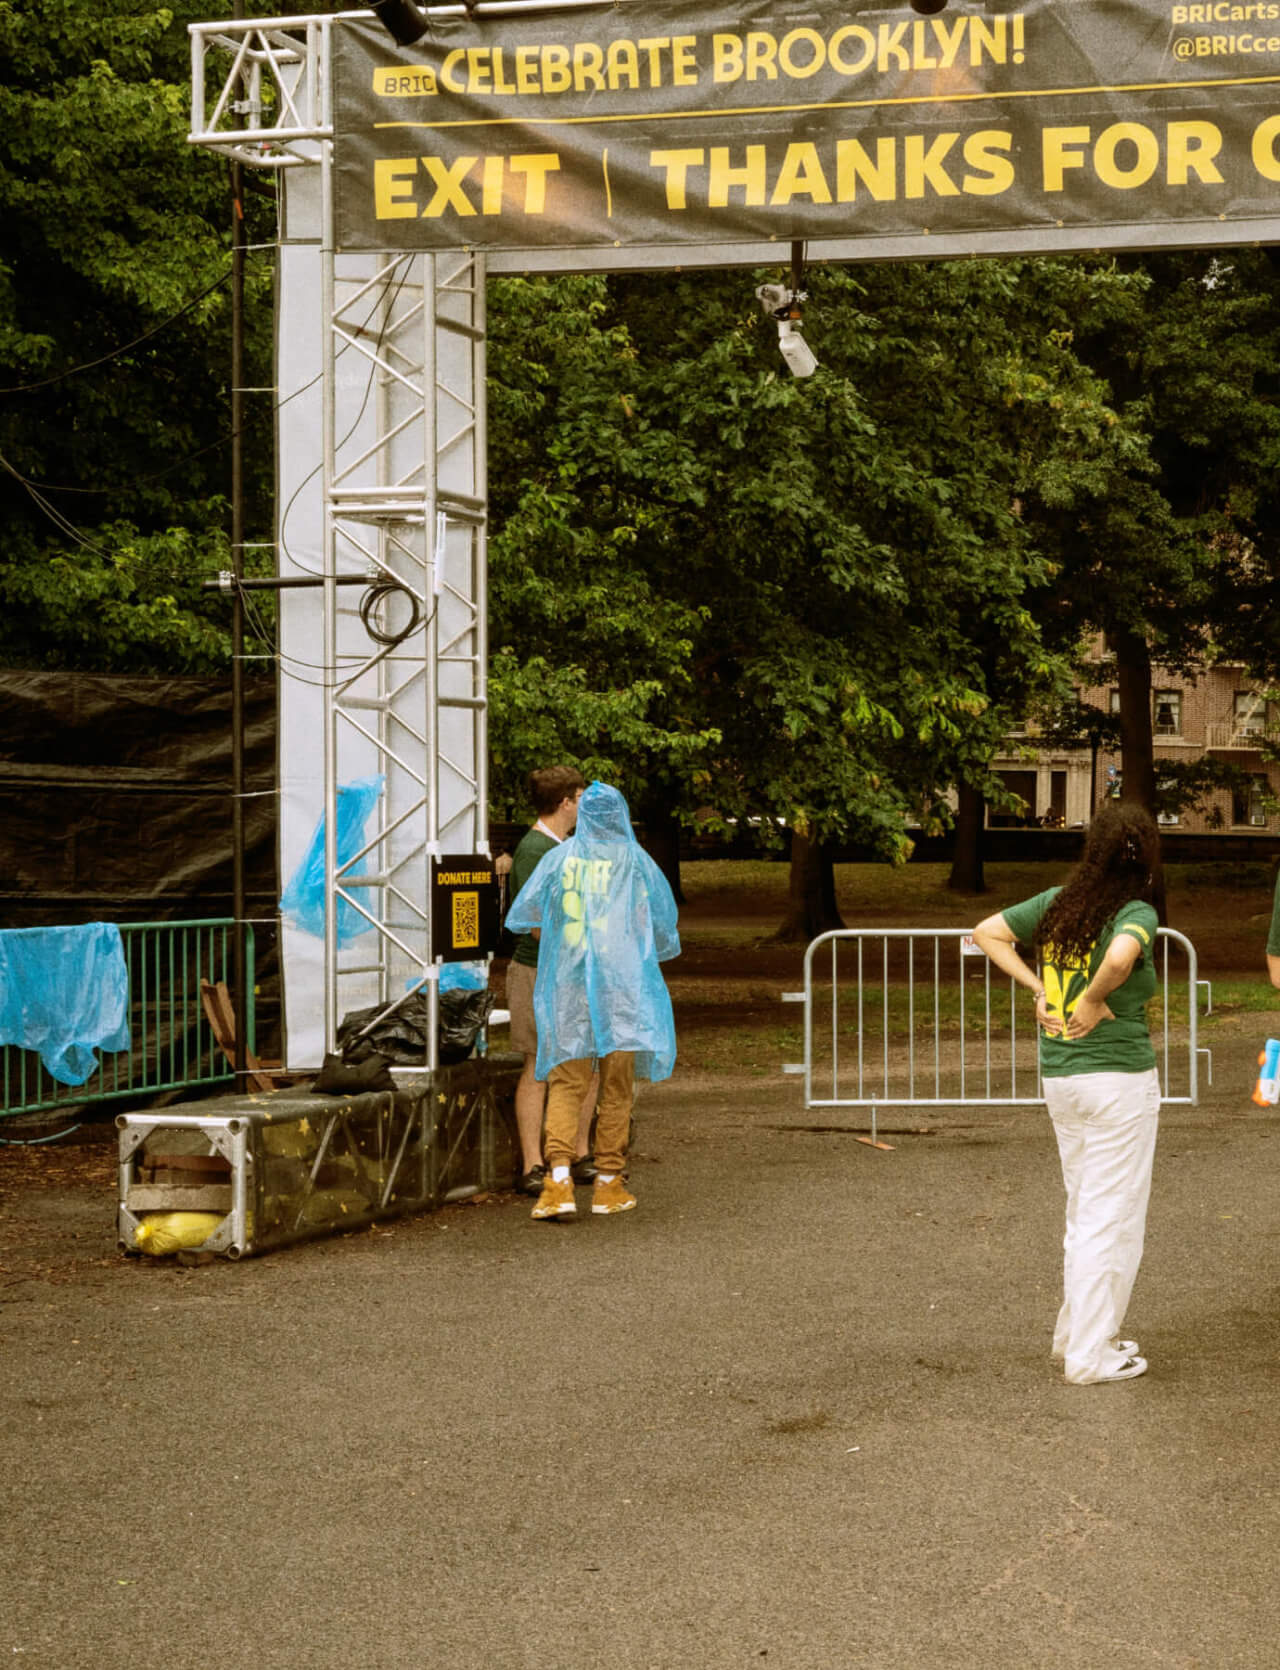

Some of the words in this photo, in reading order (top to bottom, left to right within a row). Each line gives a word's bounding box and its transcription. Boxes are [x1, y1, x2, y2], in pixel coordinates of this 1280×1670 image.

[384, 75, 434, 94] BRIC
[442, 35, 698, 95] CELEBRATE
[713, 14, 1026, 82] BROOKLYN!
[374, 153, 560, 220] EXIT
[650, 130, 1015, 210] THANKS
[1042, 118, 1225, 192] FOR
[437, 871, 471, 885] DONATE
[471, 871, 492, 884] HERE
